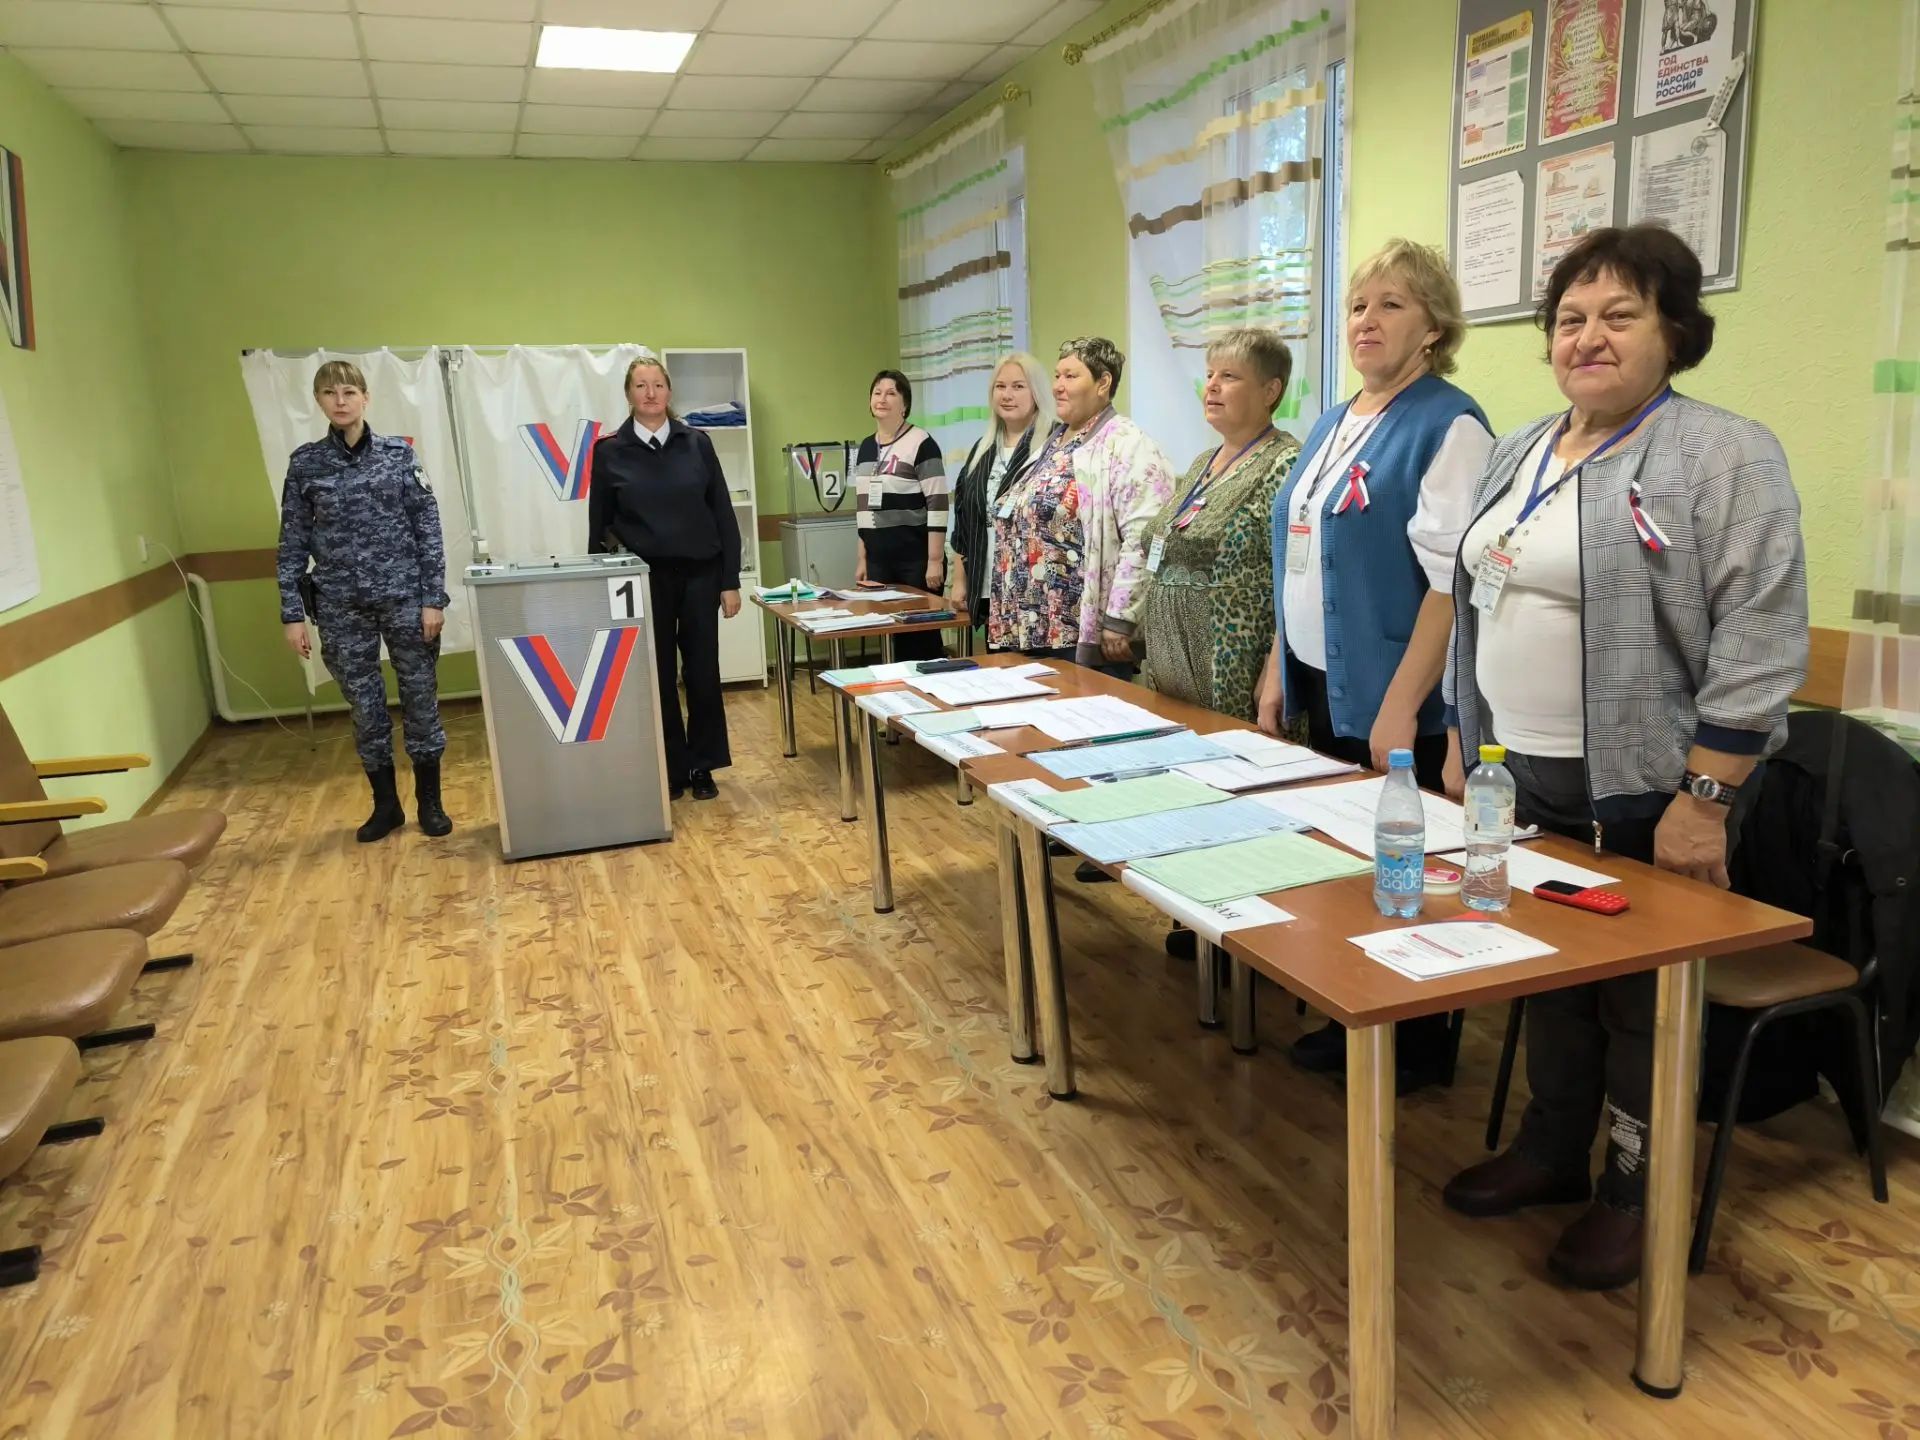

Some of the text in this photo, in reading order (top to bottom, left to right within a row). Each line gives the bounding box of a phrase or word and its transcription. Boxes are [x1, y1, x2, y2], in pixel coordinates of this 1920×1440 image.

[1657, 56, 1709, 78] ЕДИНСТВА
[1659, 55, 1678, 68] ГОД
[1656, 67, 1704, 89] НАРОДОВ
[1655, 80, 1697, 99] РОССИИ
[824, 473, 839, 496] 2
[615, 580, 635, 618] 1
